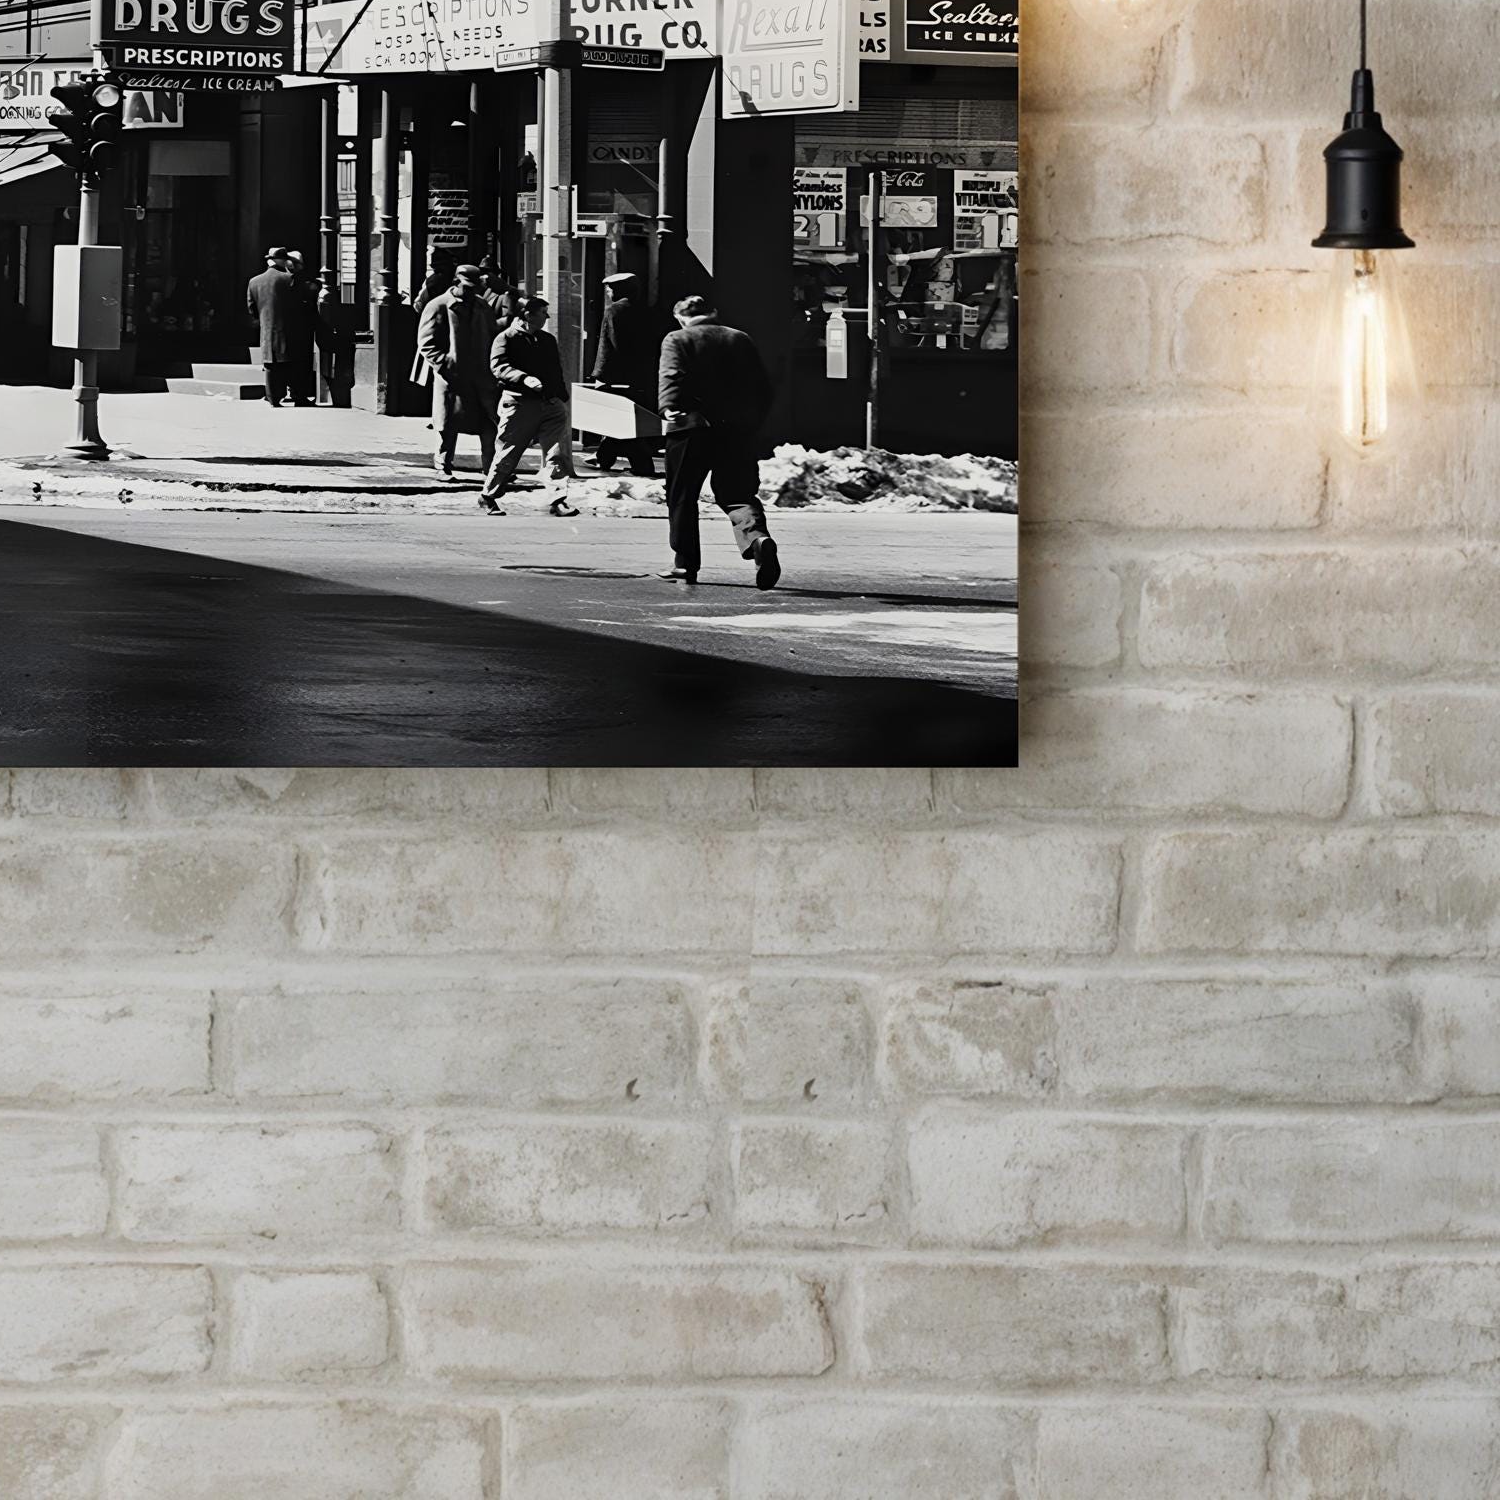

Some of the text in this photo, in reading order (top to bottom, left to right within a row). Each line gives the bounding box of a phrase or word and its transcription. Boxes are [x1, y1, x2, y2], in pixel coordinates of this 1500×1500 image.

[661, 20, 708, 49] CO.
[124, 48, 283, 68] PRESCRIPTIONS
[202, 77, 223, 90] ICE
[227, 78, 275, 92] CREAM
